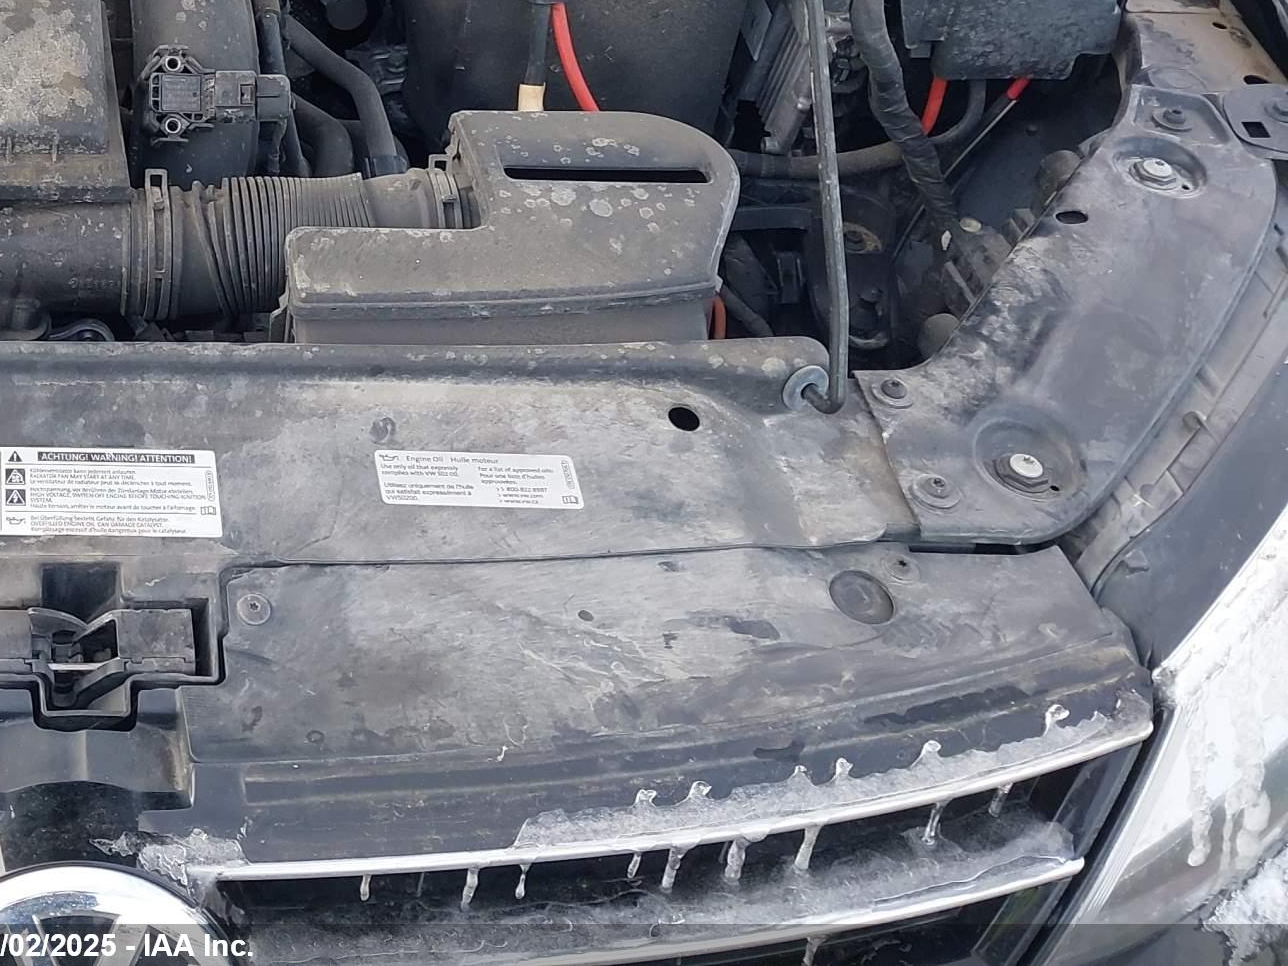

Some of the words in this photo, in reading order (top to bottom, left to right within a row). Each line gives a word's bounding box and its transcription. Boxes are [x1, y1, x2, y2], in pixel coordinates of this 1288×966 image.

[41, 453, 88, 461] ACHTUNG!
[91, 454, 137, 462] WARNING!
[140, 455, 192, 463] ATTENTION!
